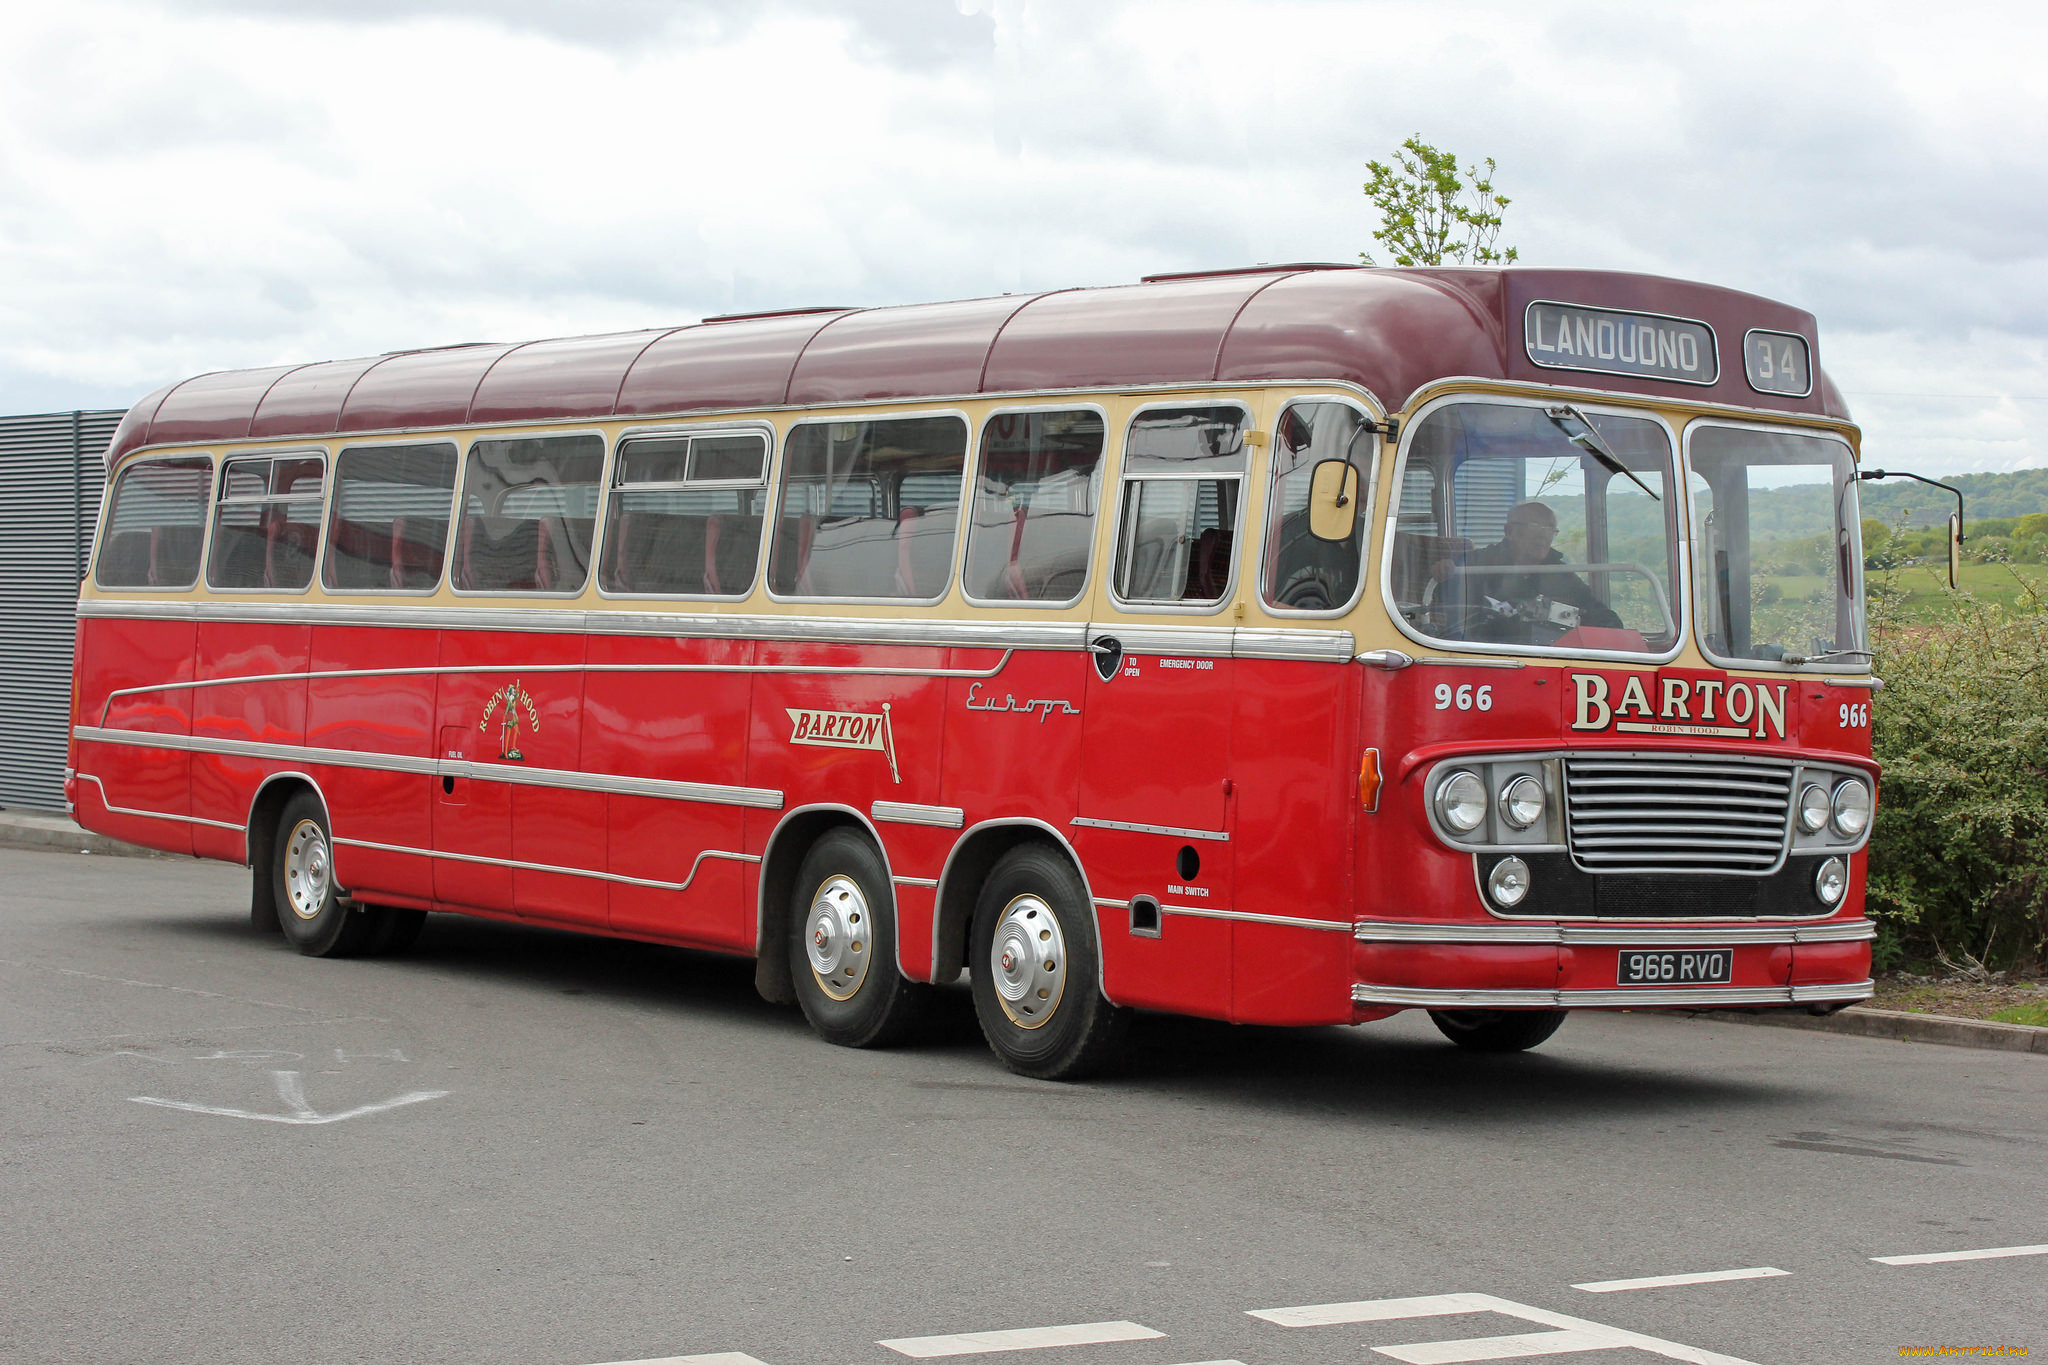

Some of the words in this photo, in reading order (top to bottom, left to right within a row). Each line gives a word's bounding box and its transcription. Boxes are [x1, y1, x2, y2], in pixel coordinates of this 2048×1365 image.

[1528, 310, 1698, 372] LANDUDNO
[1757, 340, 1796, 381] 34
[1124, 667, 1140, 677] OPEN
[1129, 657, 1137, 667] TO
[1159, 658, 1195, 669] EMERGENCY
[1196, 660, 1214, 670] DOOR
[479, 688, 503, 733] ROBIN
[519, 689, 540, 733] HOOD
[966, 682, 1081, 723] Europa
[1434, 683, 1493, 712] 966
[1571, 673, 1789, 740] BARTON
[794, 712, 882, 745] BARTON
[1651, 724, 1684, 733] ROBIN
[1689, 726, 1720, 735] HOOD
[1839, 703, 1867, 728] 966
[1167, 884, 1183, 895] MAIN
[1185, 886, 1209, 897] SWITCH
[1629, 954, 1675, 980] 966
[1680, 953, 1723, 979] RVO
